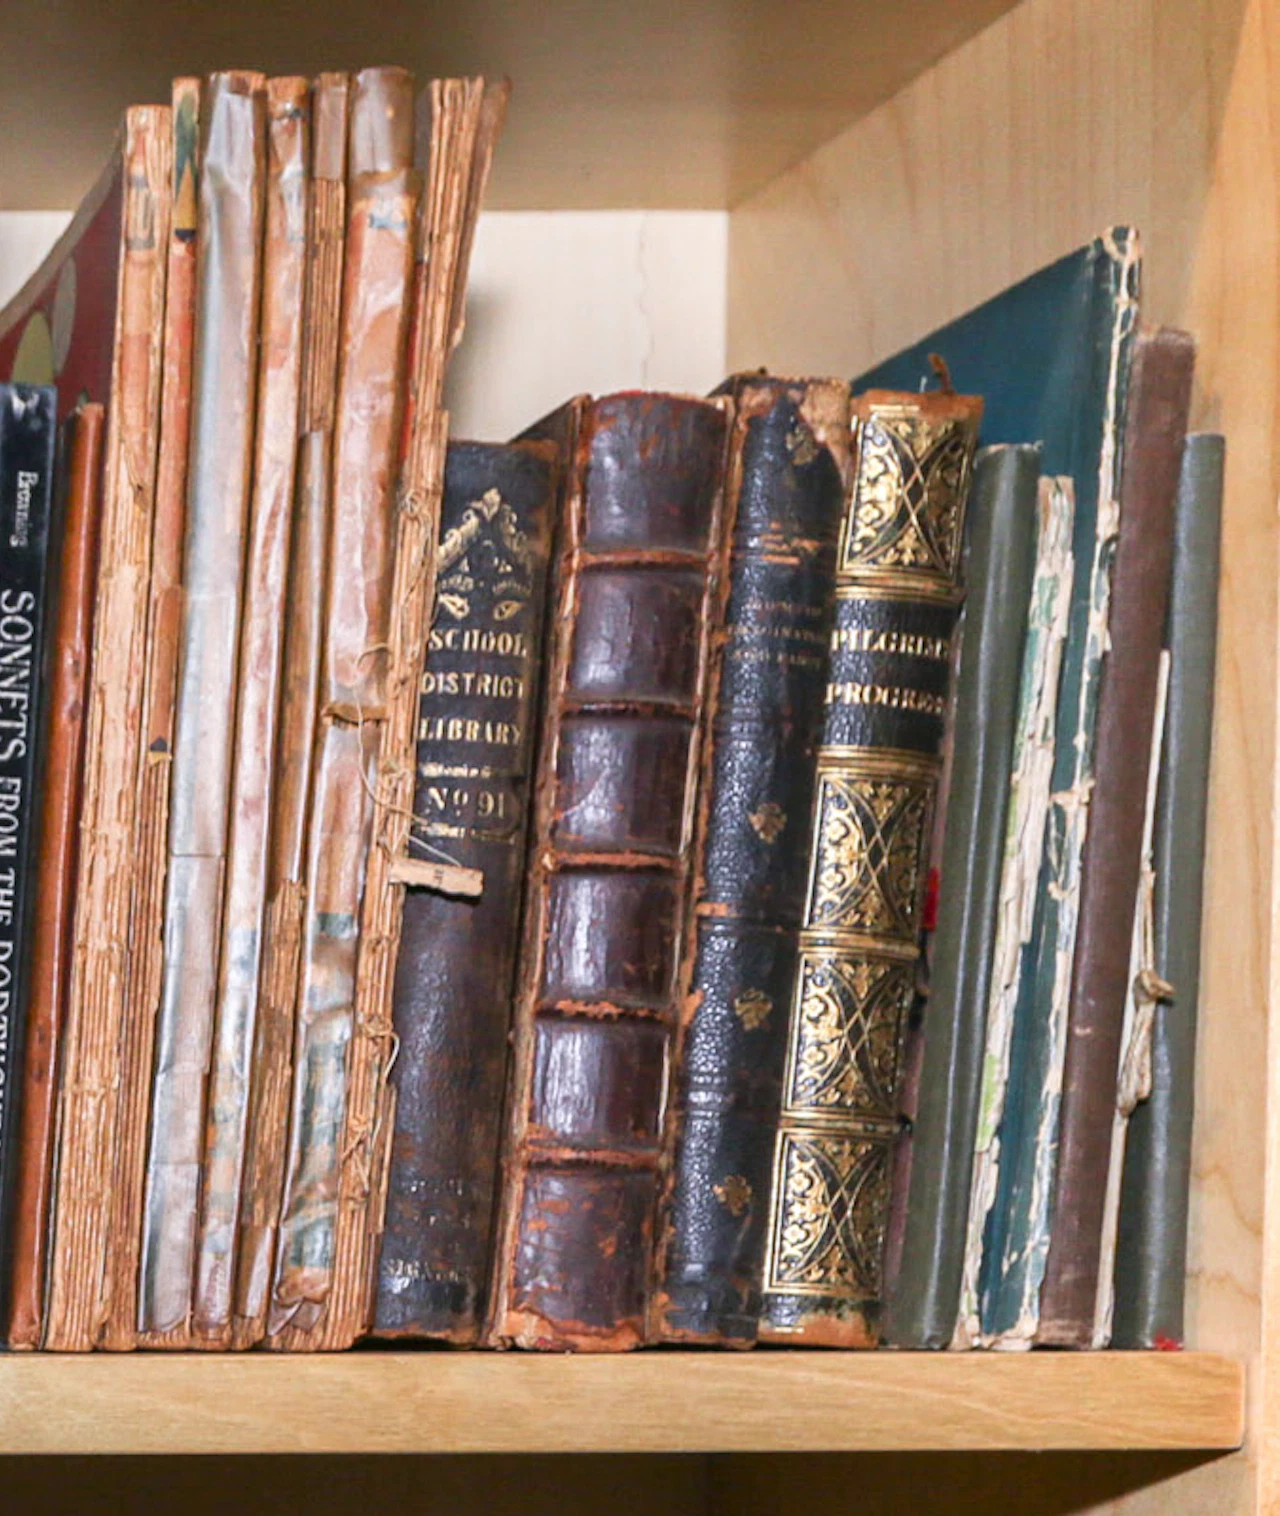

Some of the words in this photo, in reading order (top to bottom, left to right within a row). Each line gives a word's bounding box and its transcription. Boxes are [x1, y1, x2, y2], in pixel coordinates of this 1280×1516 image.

[10, 470, 38, 548] Browning
[428, 629, 527, 658] SCHOOL
[420, 671, 523, 698] DISTRICT
[419, 718, 522, 745] LIBRARY
